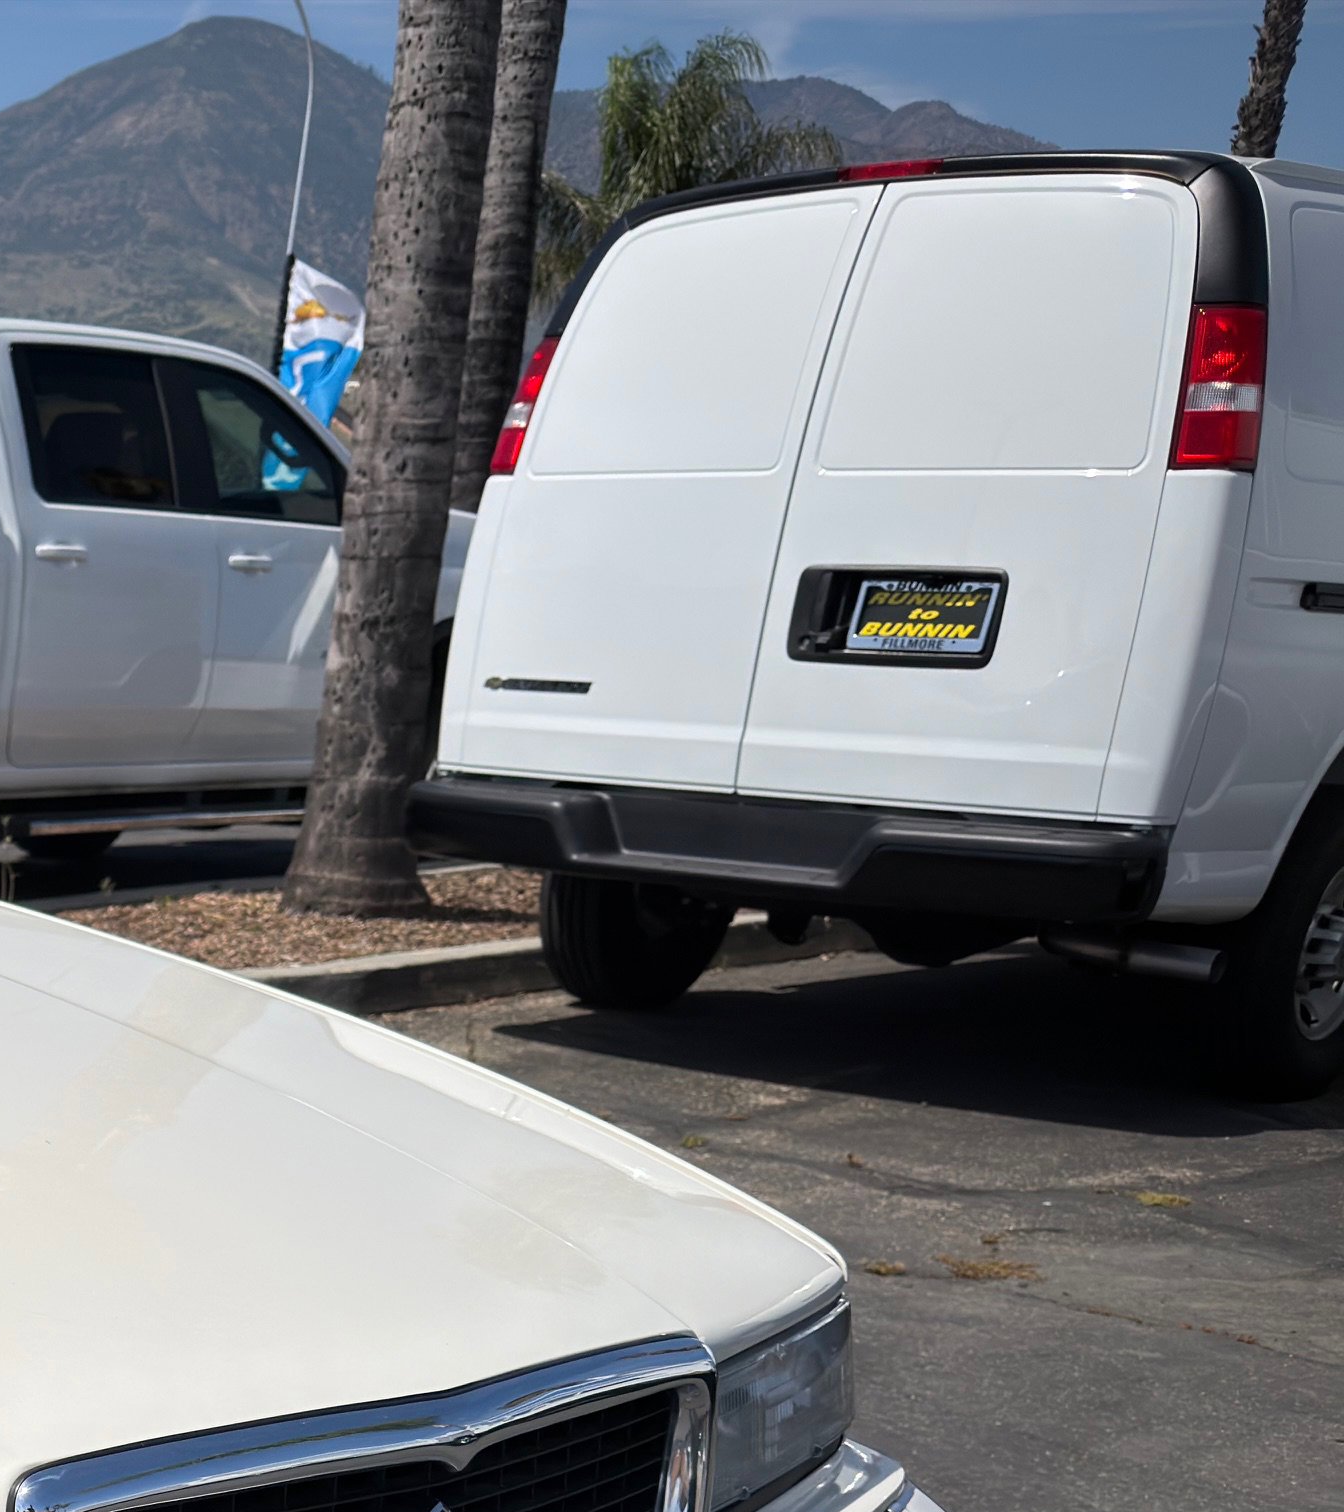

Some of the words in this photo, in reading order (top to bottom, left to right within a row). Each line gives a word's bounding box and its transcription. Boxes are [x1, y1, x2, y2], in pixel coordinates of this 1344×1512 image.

[868, 591, 990, 607] RUNNIN'
[907, 608, 941, 620] to
[859, 621, 976, 639] BUNNIN
[881, 637, 945, 650] FILLMORE
